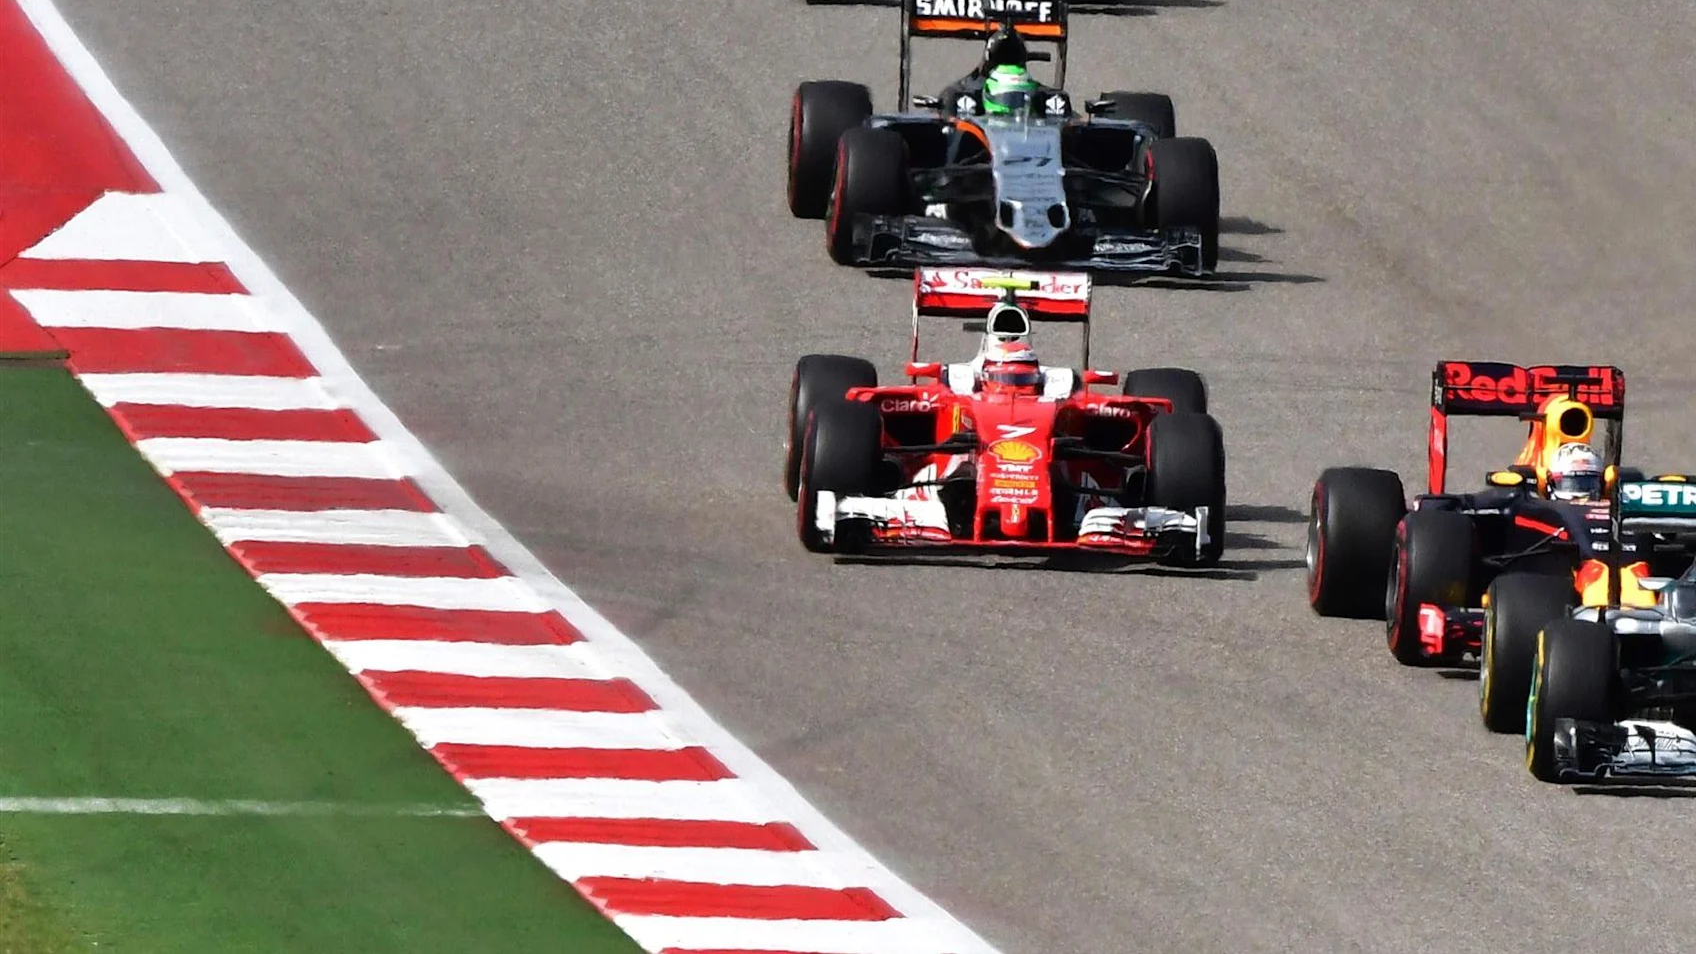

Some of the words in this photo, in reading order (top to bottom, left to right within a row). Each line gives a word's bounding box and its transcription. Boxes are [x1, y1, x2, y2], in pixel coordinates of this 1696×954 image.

[880, 397, 932, 413] Claro
[1085, 402, 1132, 418] Claro
[996, 424, 1038, 439] 7
